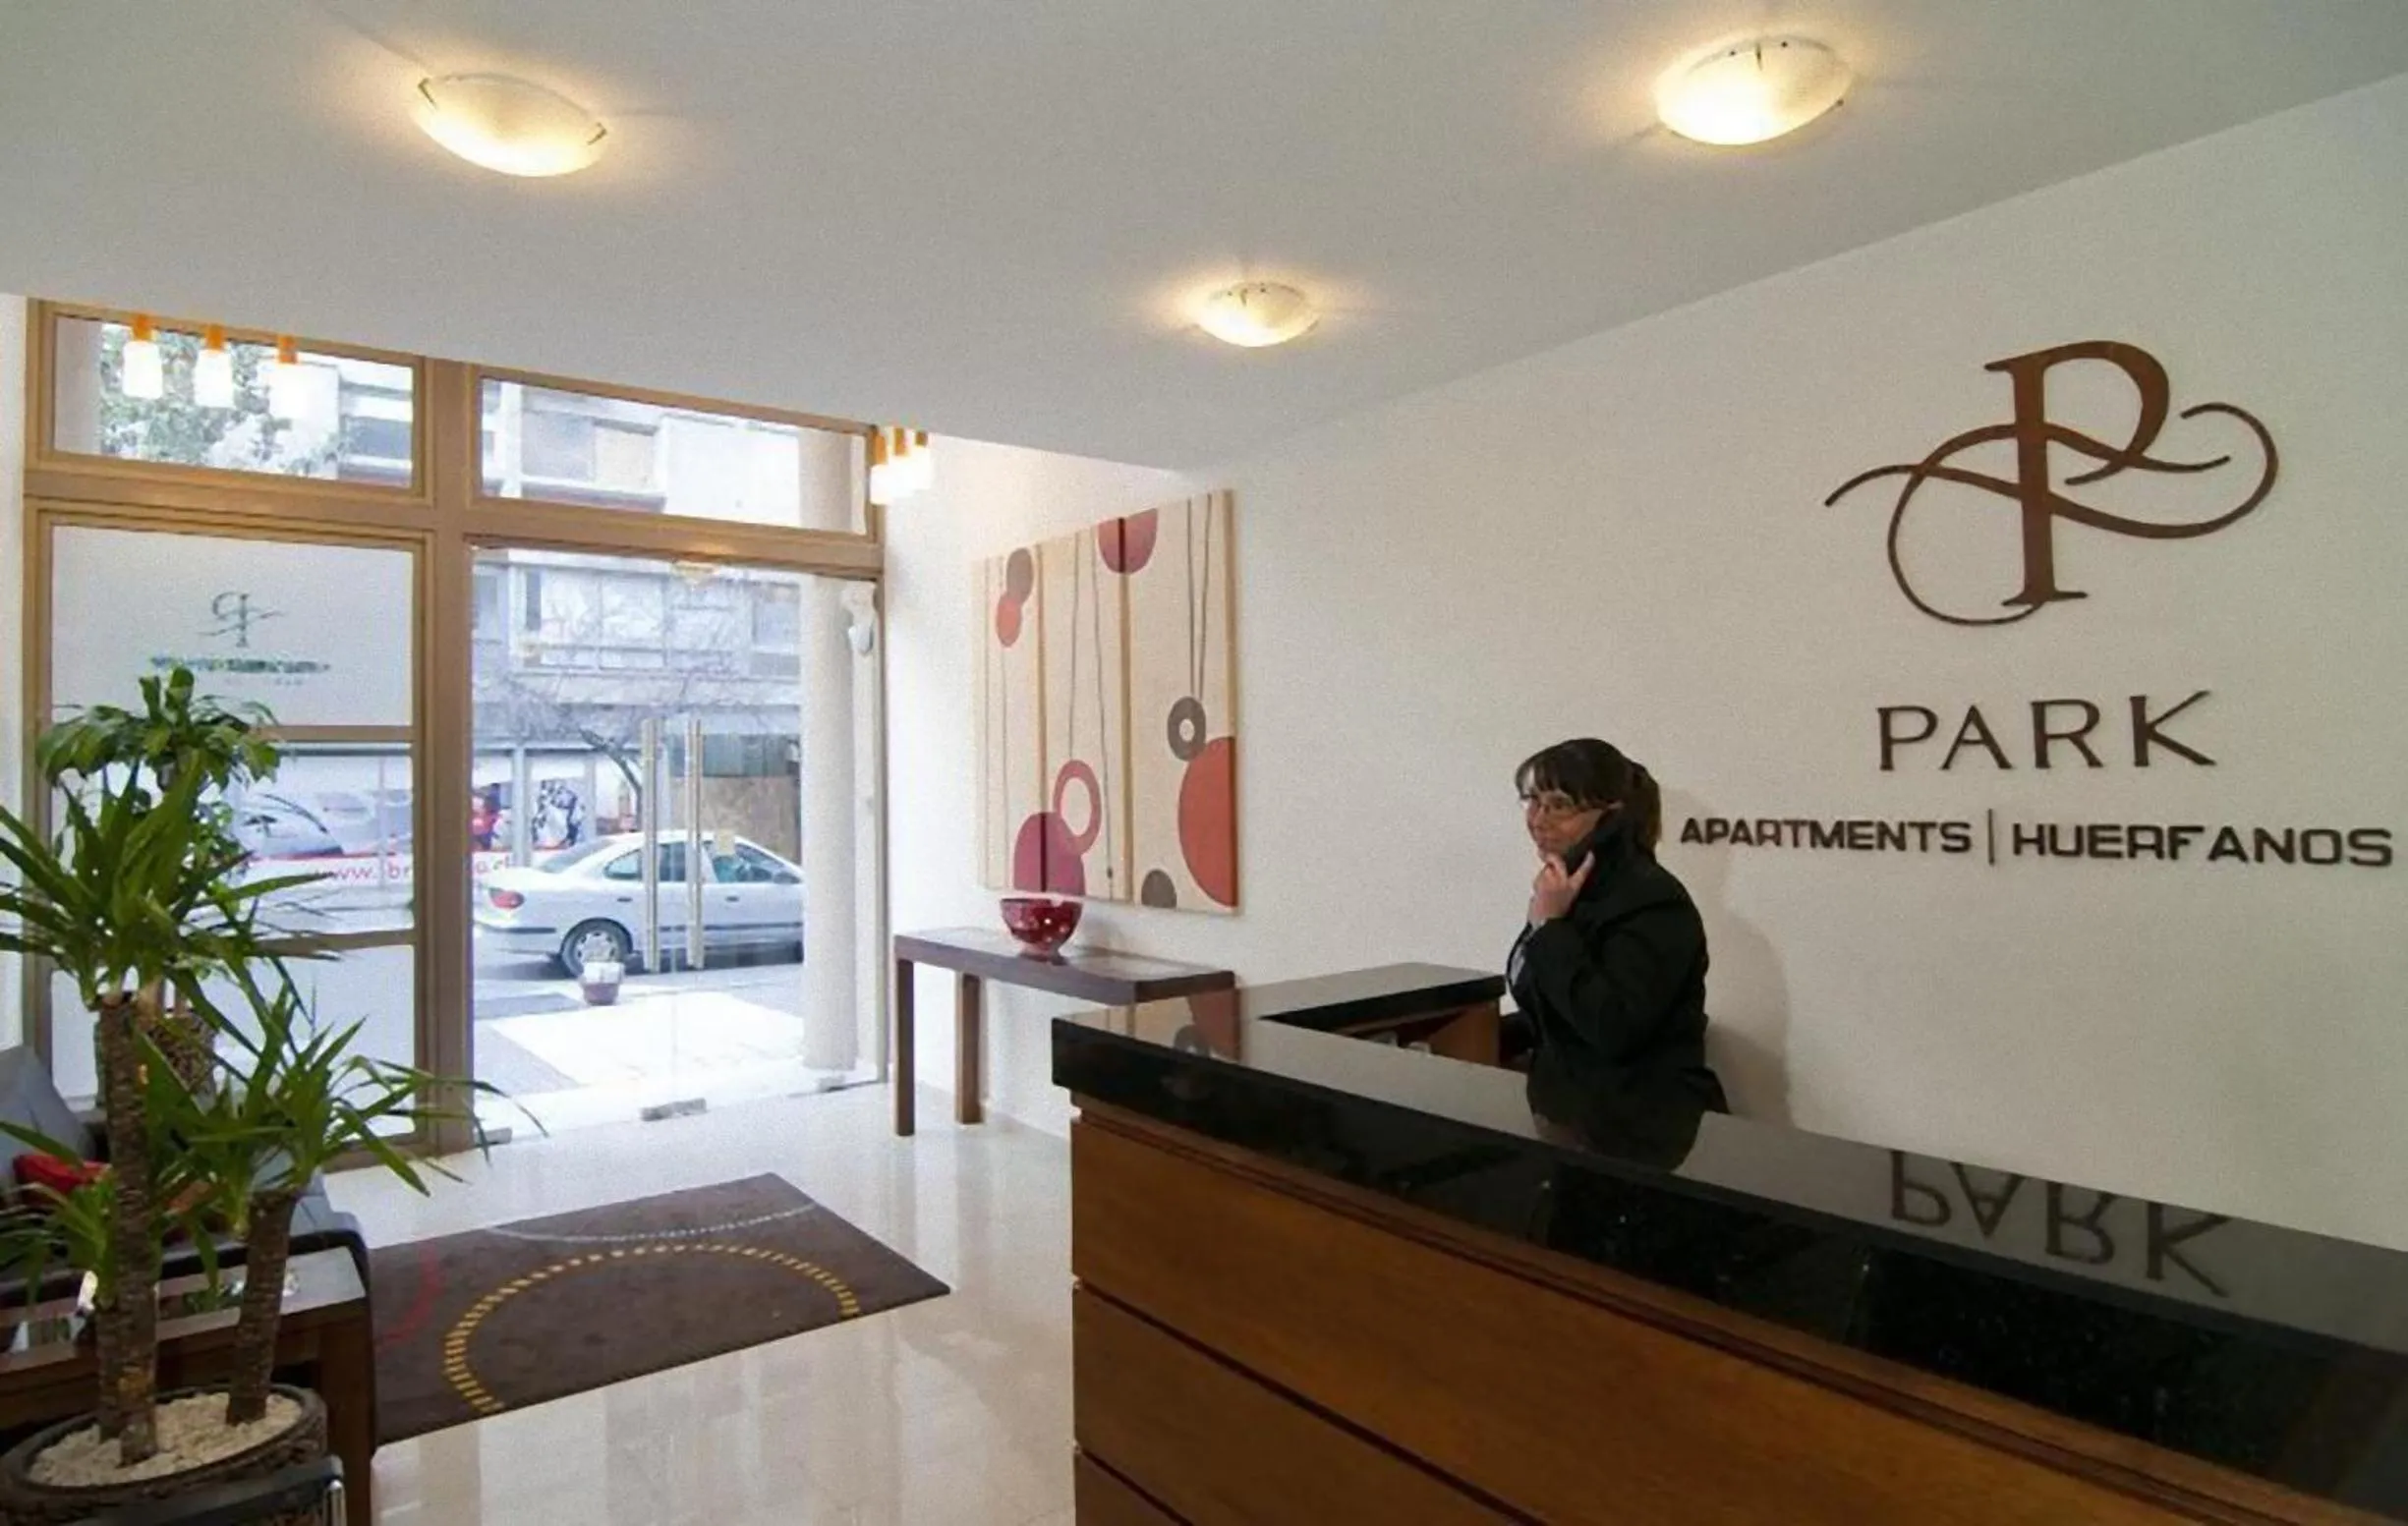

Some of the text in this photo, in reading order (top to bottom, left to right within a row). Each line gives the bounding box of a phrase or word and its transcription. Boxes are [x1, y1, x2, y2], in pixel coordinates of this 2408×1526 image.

[1876, 690, 2218, 773] PARK
[1679, 817, 2394, 870] APARTMENTS HUERFANOS
